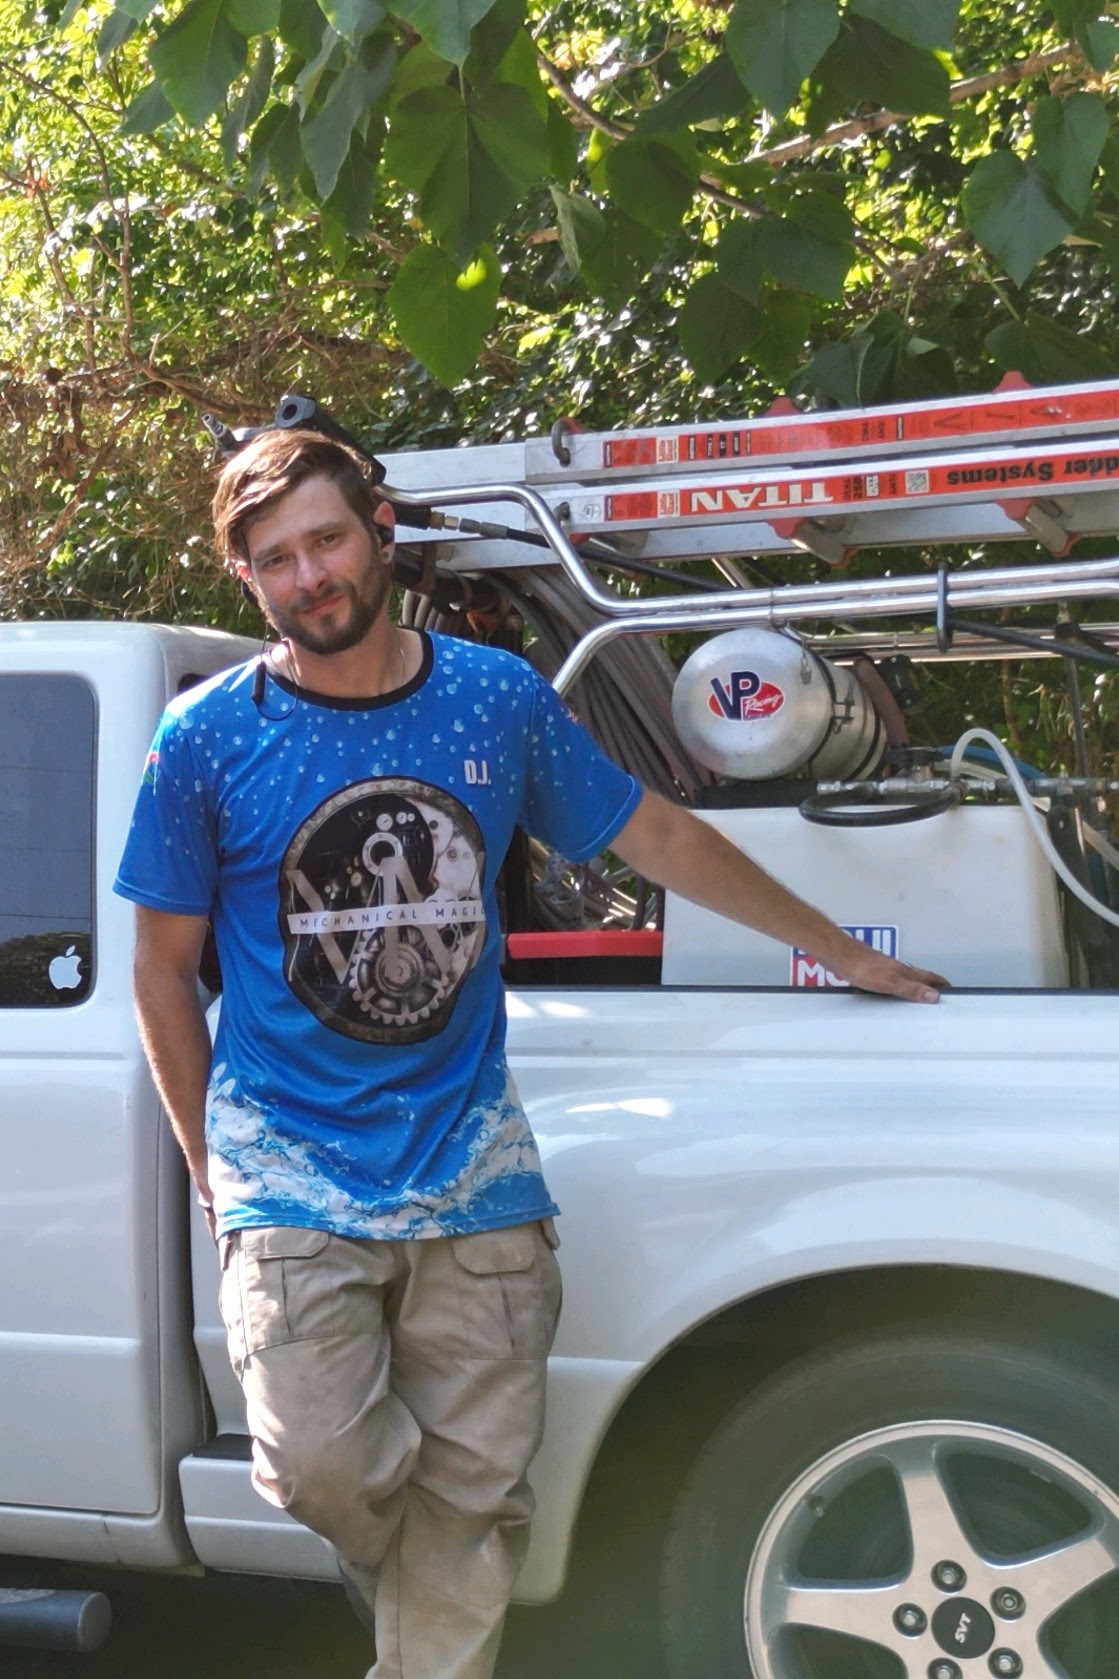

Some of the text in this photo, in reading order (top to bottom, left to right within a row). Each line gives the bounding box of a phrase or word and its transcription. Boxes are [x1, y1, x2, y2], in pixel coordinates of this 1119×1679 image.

[946, 461, 1054, 485] Systems
[691, 481, 834, 512] TITAN
[710, 671, 761, 721] VP
[464, 759, 492, 785] D.J.
[299, 910, 418, 928] MECHANICAL
[954, 1612, 971, 1644] SVT
